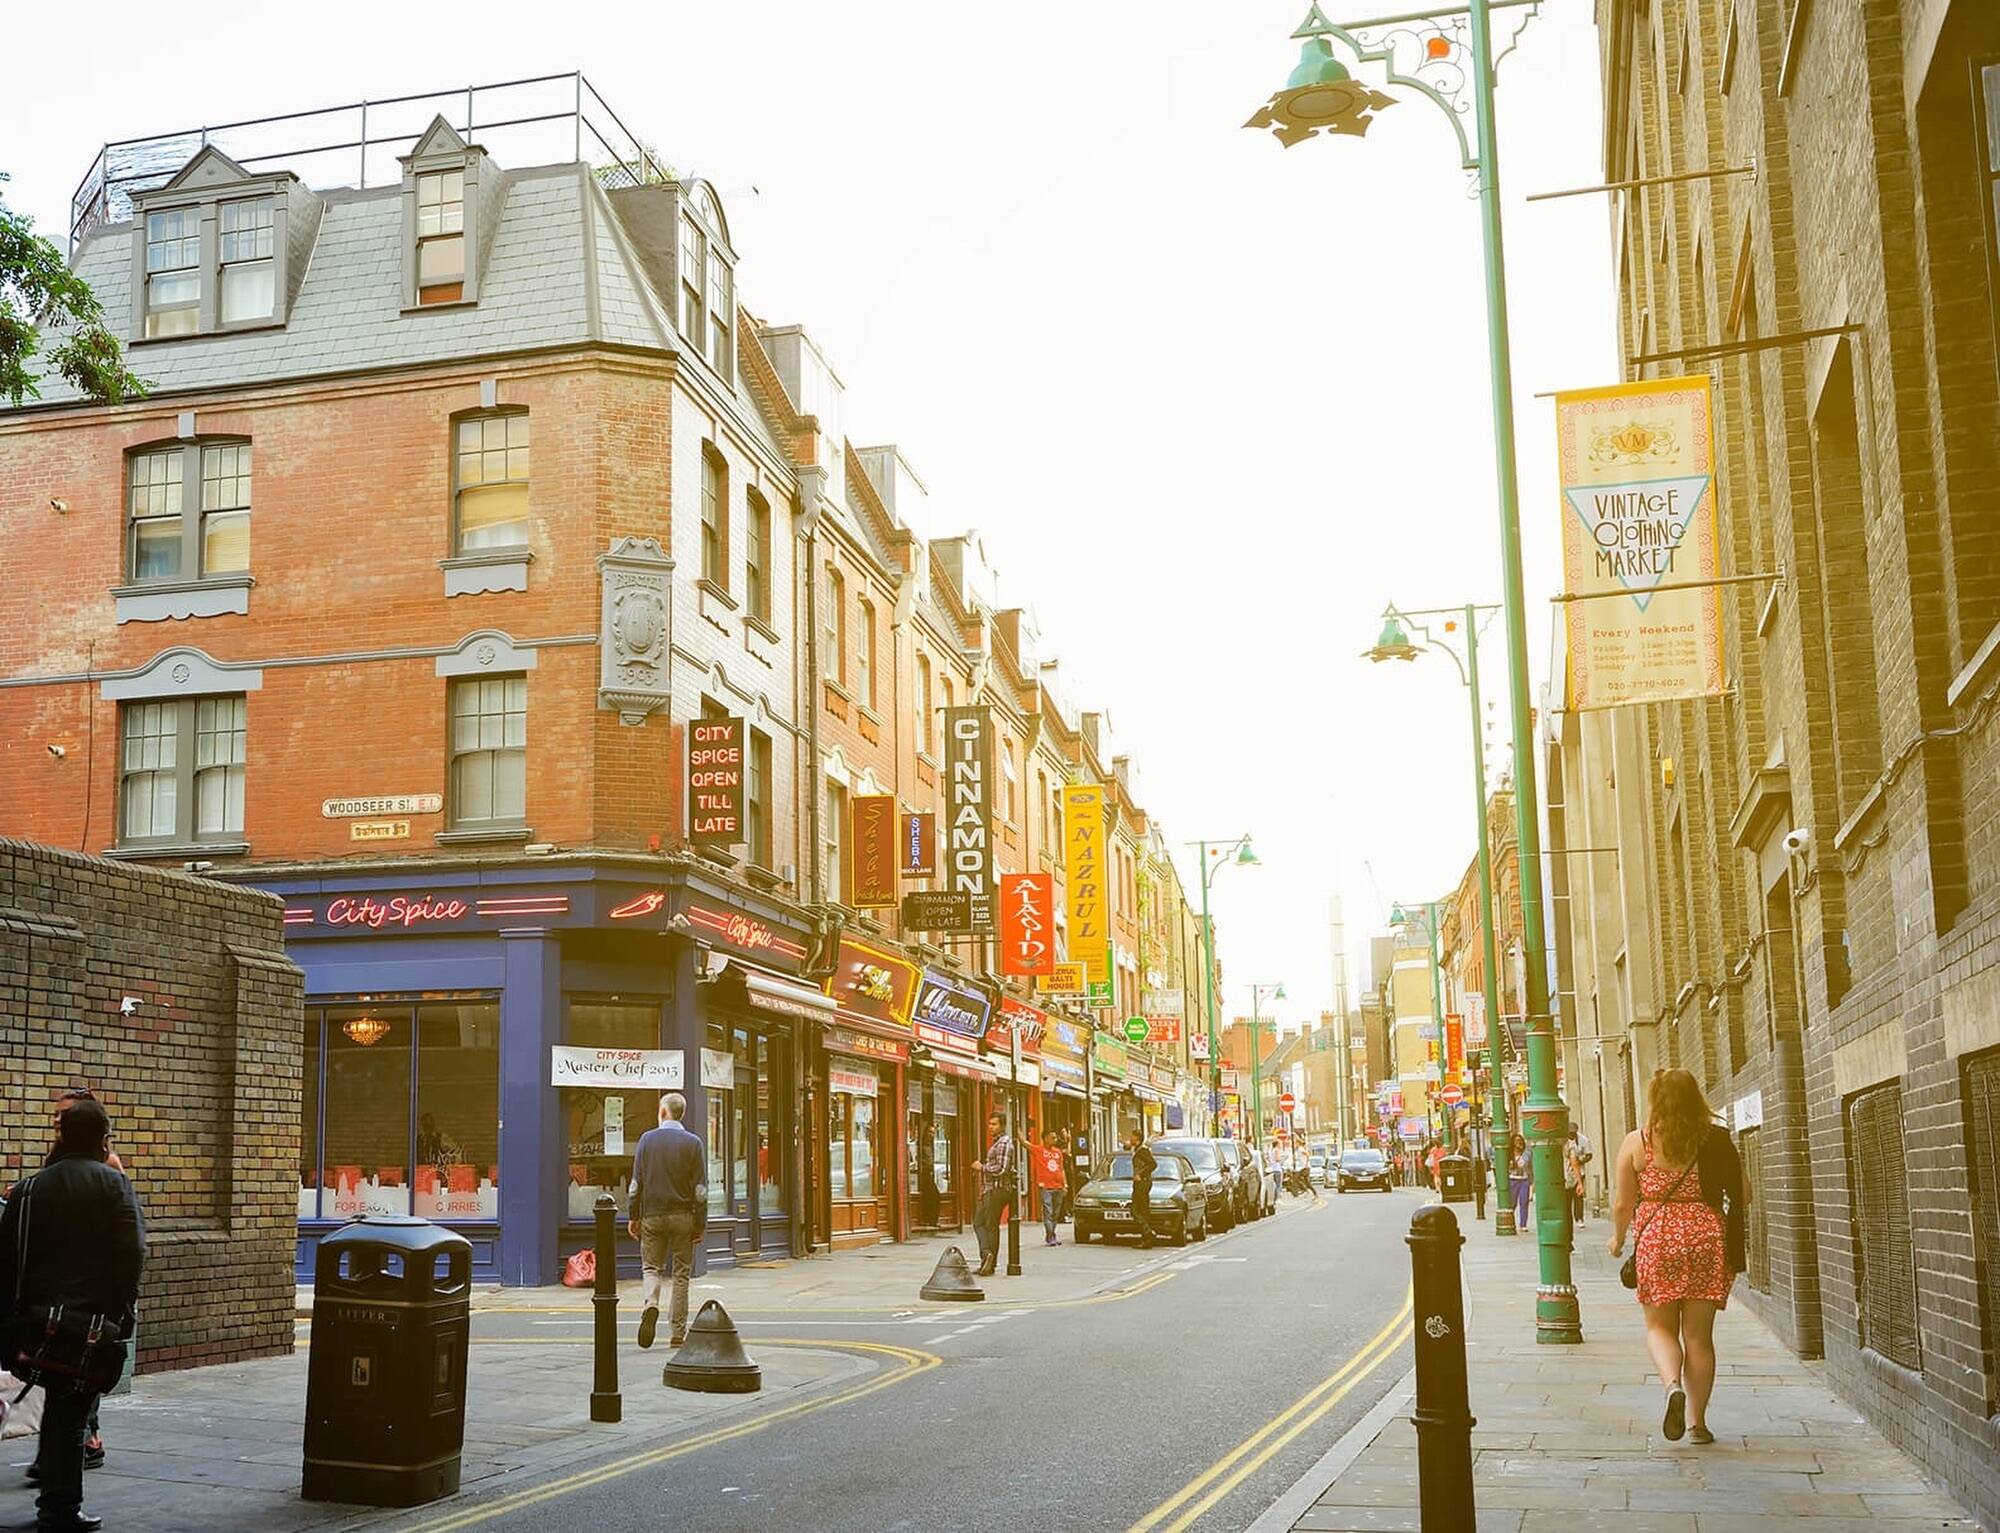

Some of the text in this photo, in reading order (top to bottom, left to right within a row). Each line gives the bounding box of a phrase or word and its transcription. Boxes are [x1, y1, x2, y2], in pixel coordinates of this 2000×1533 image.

[1594, 490, 1678, 519] VINTAGE
[1594, 519, 1686, 549] CLOTHING
[1595, 545, 1681, 578] MARKET
[1593, 624, 1695, 638] Every Weekend
[695, 726, 732, 740] CITY
[691, 748, 739, 765] SPICE
[691, 772, 738, 787] OPEN
[328, 800, 393, 815] WOODSEER
[697, 794, 732, 809] TILL
[952, 719, 986, 894] CINNAMON
[694, 817, 736, 832] LATE
[911, 816, 920, 867] SHEBA
[1072, 827, 1097, 938] NAZRUL
[327, 895, 467, 928] City Spice
[926, 907, 954, 916] OPEN
[727, 914, 748, 942] City
[937, 916, 962, 927] LATE
[596, 1051, 643, 1061] CITY SPICE
[558, 1059, 610, 1075] Master
[613, 1062, 650, 1079] Chef
[338, 1308, 385, 1321] LITTER
